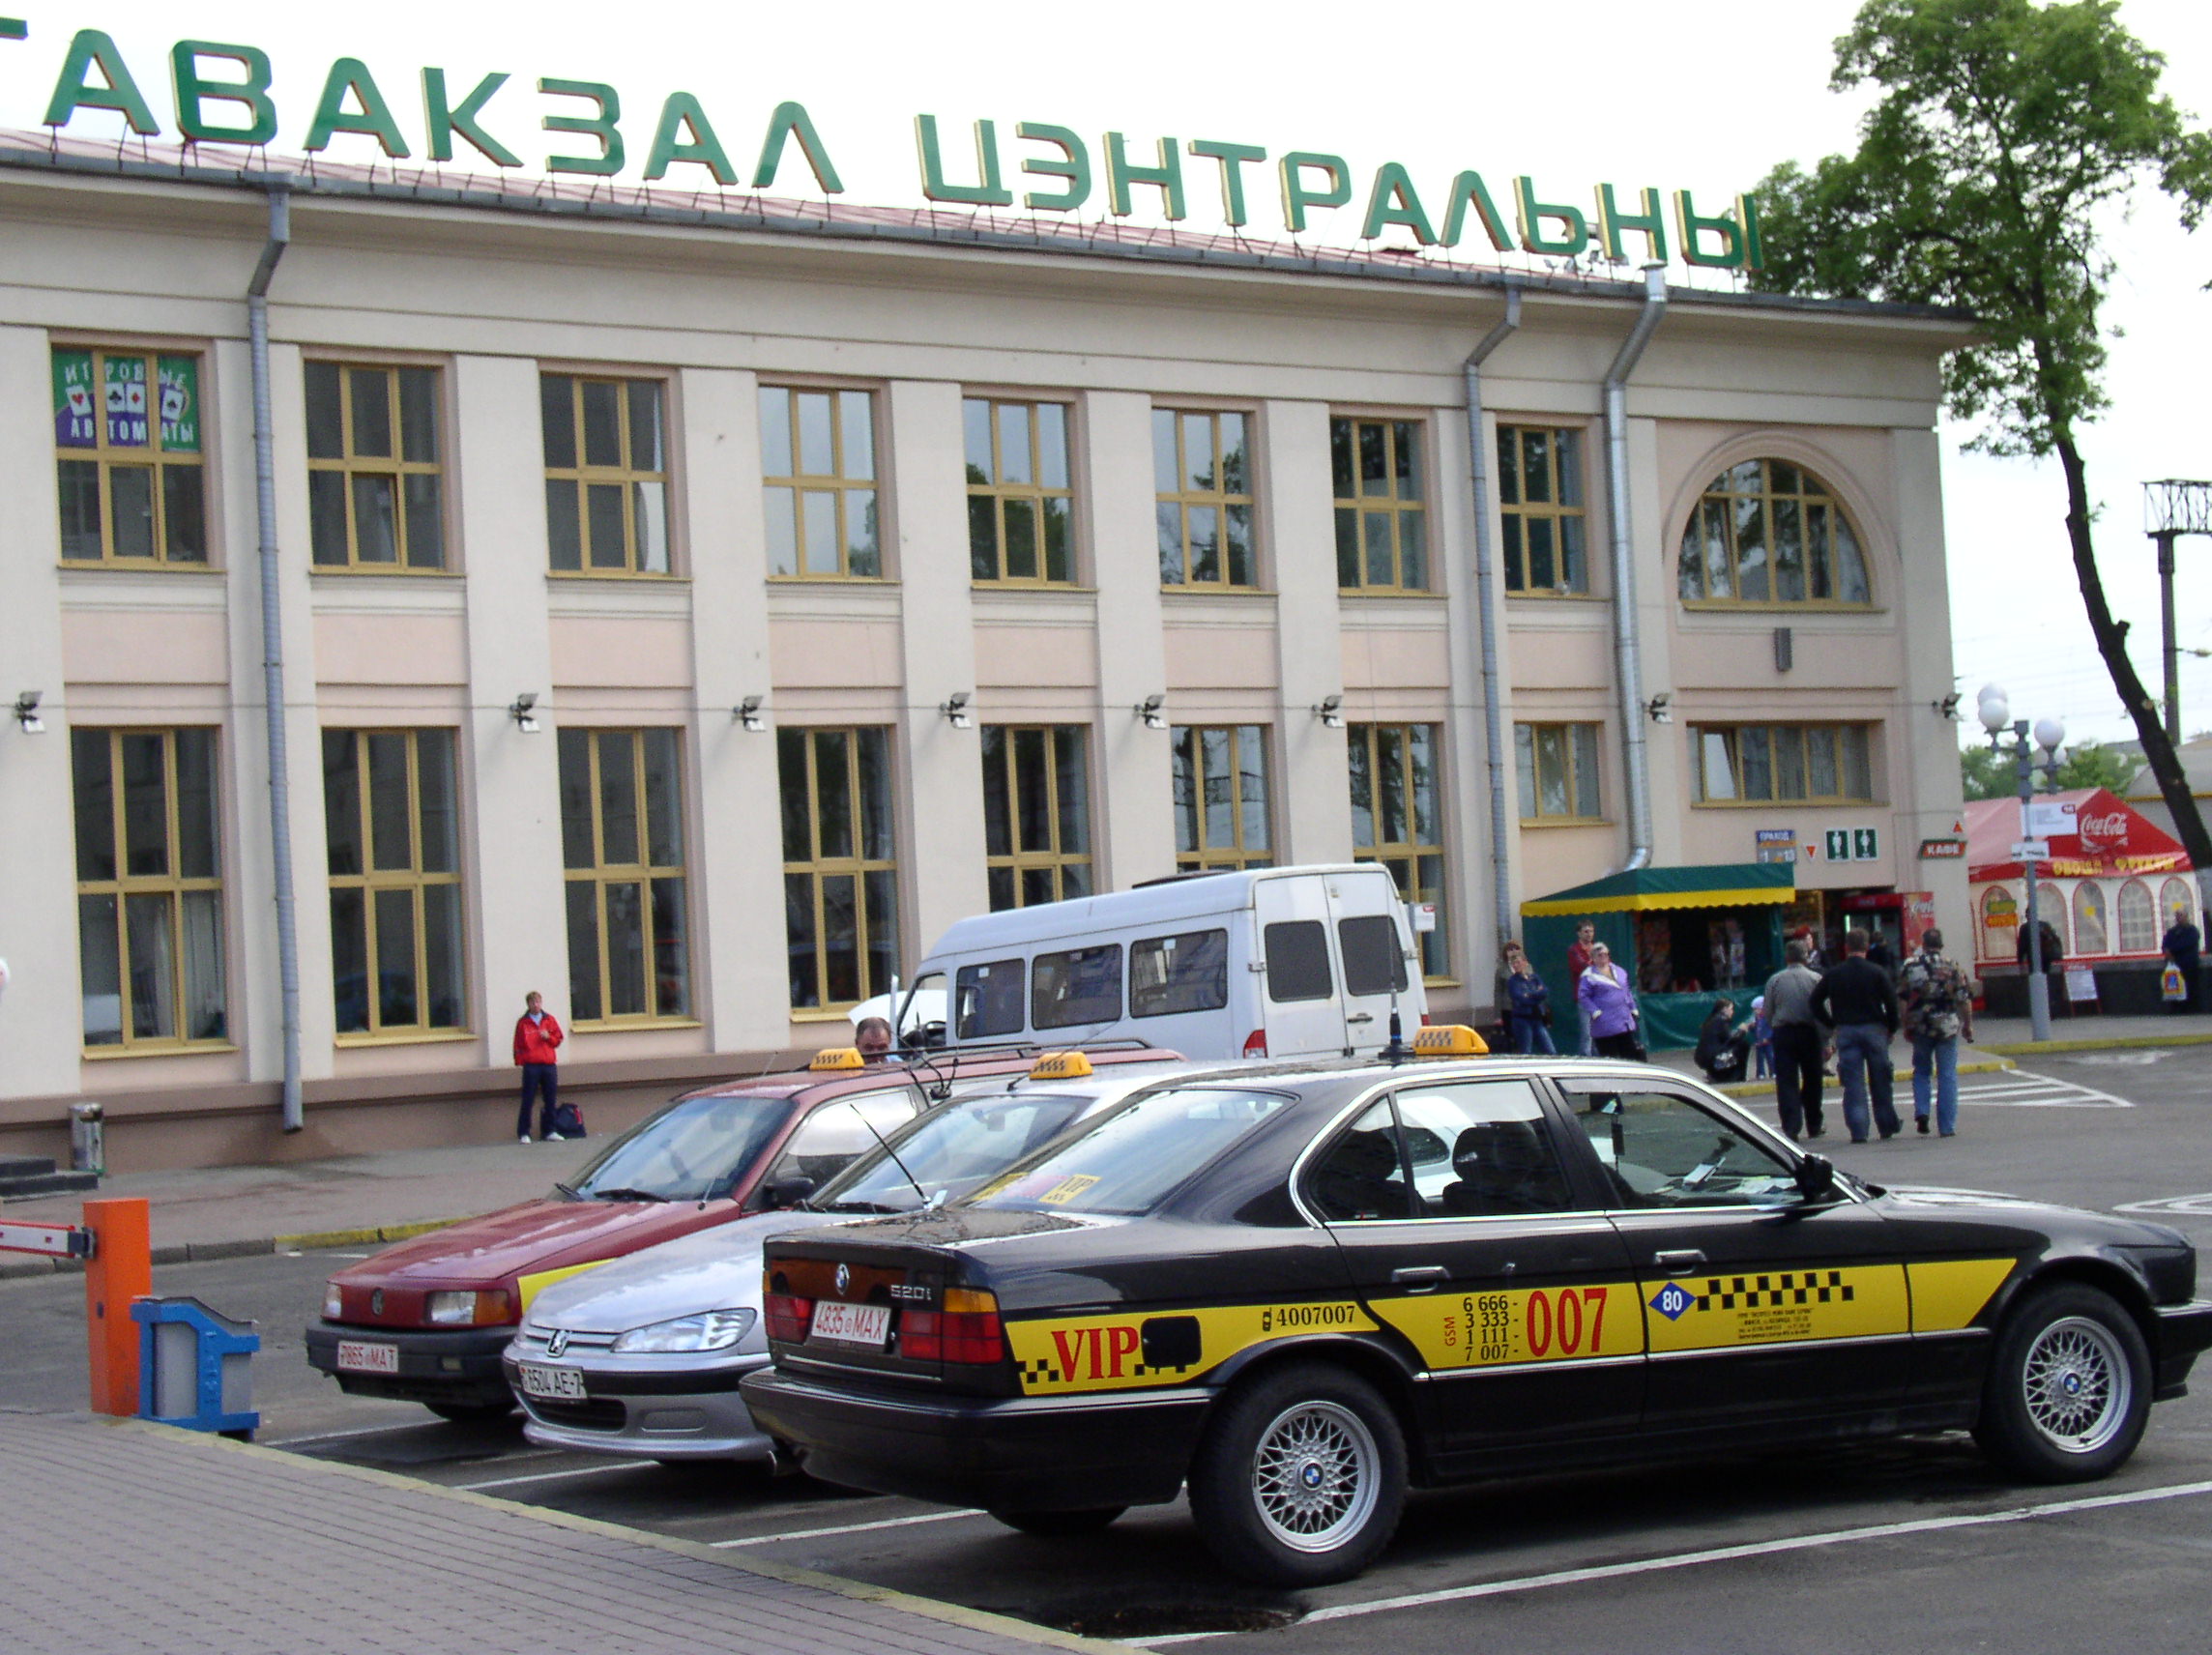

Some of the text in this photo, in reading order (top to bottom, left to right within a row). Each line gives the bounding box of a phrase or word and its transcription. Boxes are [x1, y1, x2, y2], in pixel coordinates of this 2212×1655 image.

[913, 113, 1763, 272] ЦЭНТРАЛЬНЫ
[65, 361, 187, 391] ИГРОВЫЕ
[71, 417, 194, 443] АВТОМАТЫ
[890, 1284, 932, 1300] 520i
[1463, 1296, 1473, 1312] 6
[1478, 1294, 1508, 1311] 666
[1662, 1291, 1683, 1312] 80
[816, 1305, 846, 1334] 4835
[1276, 1305, 1355, 1326] 4007007
[1465, 1313, 1474, 1328] 3
[1481, 1311, 1509, 1327] 333
[1527, 1288, 1607, 1357] 007
[1443, 1316, 1456, 1346] GSM
[1480, 1327, 1507, 1344] 111
[1051, 1326, 1140, 1381] VIP
[1466, 1346, 1473, 1361] 7
[1480, 1343, 1509, 1361] 007
